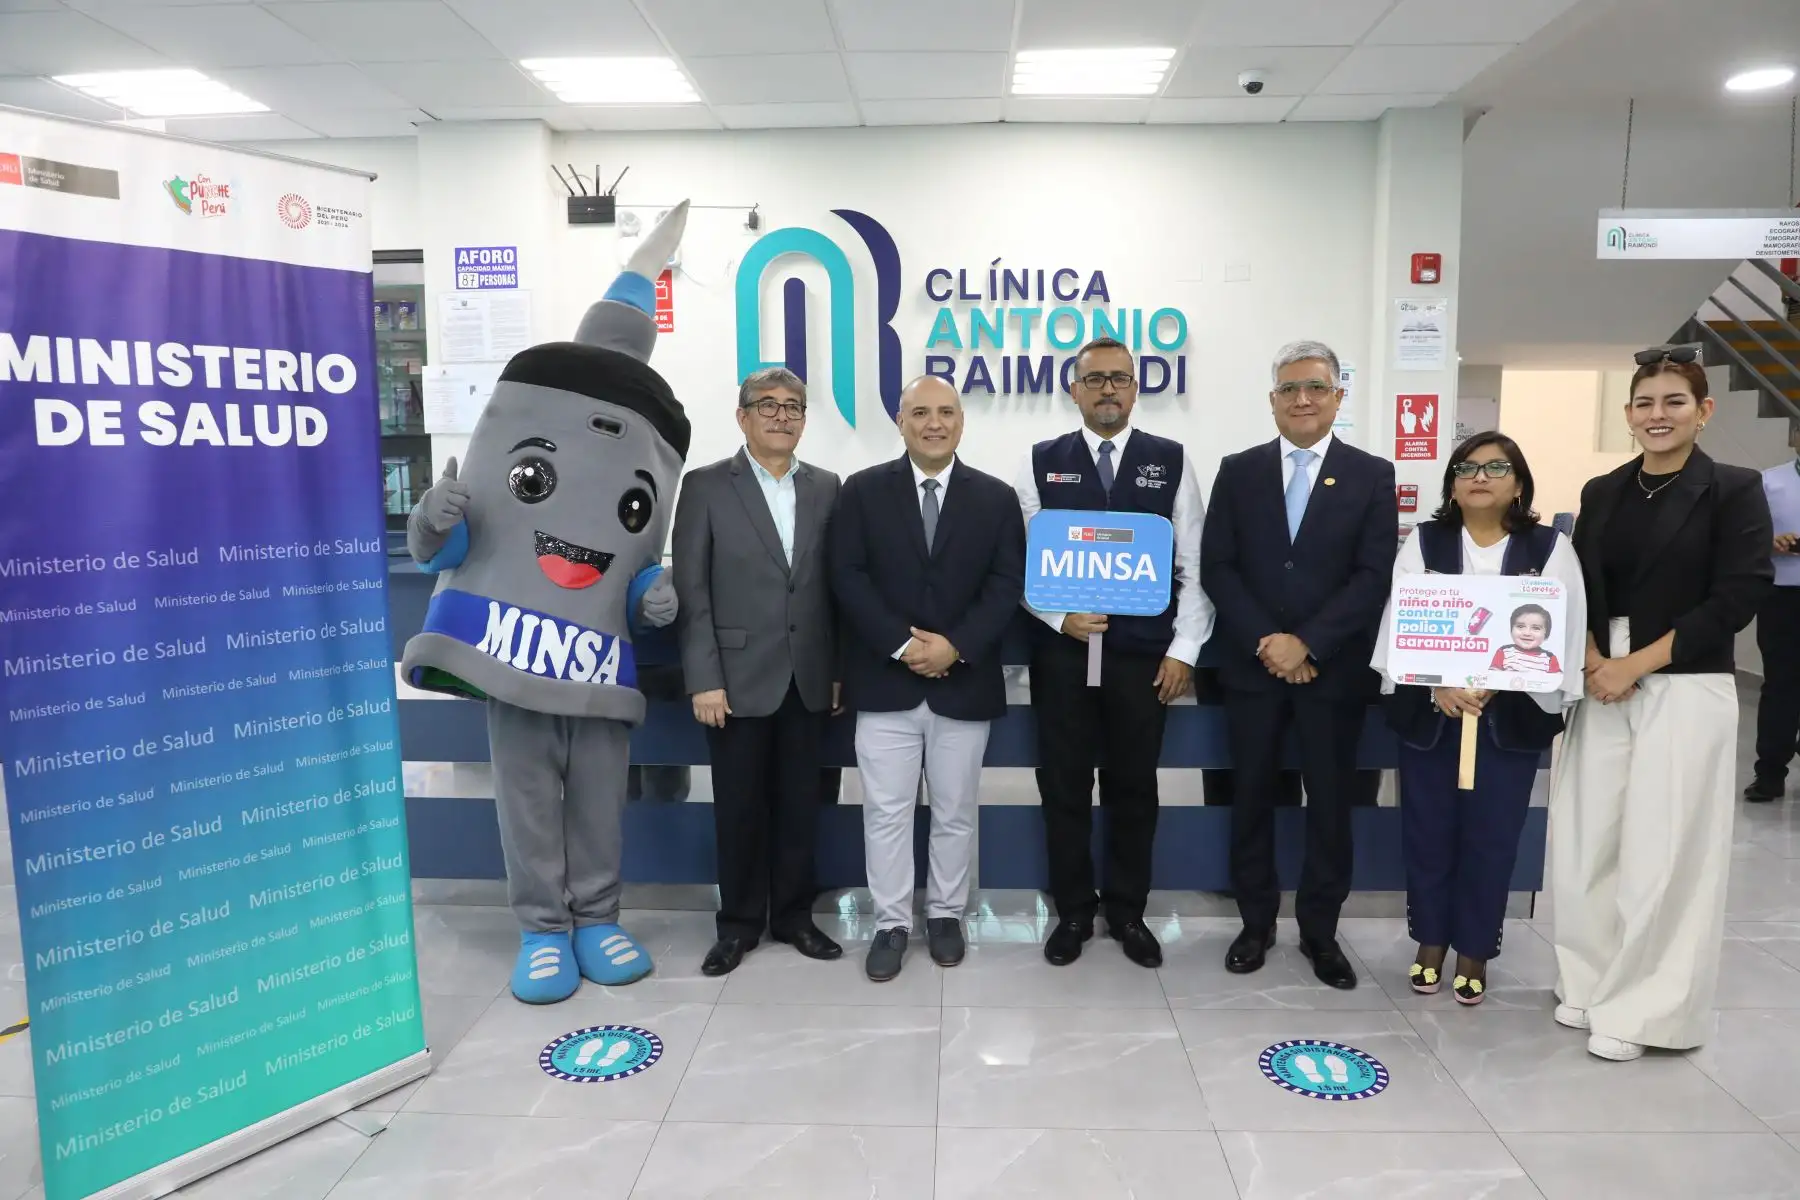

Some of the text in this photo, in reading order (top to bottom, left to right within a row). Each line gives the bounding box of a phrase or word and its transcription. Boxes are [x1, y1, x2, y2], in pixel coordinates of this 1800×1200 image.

[198, 174, 210, 183] Con
[202, 200, 226, 215] Perú
[316, 206, 362, 218] BICENTENARIO
[458, 249, 514, 264] AFORO
[462, 274, 516, 286] 87 PERSONAS
[926, 257, 1110, 302] CLÍNICA
[926, 306, 1188, 350] ANTONIO
[0, 333, 356, 394] MINISTERIO
[34, 398, 328, 446] DE SALUD
[0, 547, 198, 577] Ministerio de Salud
[220, 537, 380, 562] Ministerio de Salud
[1041, 549, 1157, 582] MINSA
[155, 588, 270, 608] Ministerio de Salud
[283, 578, 383, 596] Ministerio de Salud
[1399, 597, 1428, 607] niña
[1443, 598, 1473, 608] niño
[1400, 588, 1437, 597] Protege
[0, 599, 136, 622] Ministerio de Salud
[1398, 609, 1458, 618] contra la
[1400, 620, 1452, 634] polio y
[227, 616, 385, 649] Ministerio de Salud
[476, 601, 621, 686] MINSA
[1398, 636, 1486, 651] sarampión
[5, 636, 206, 677] Ministerio de Salud
[289, 658, 387, 680] Ministerio de Salud
[163, 672, 276, 699] Ministerio de Salud
[10, 692, 145, 722] Ministerio de Salud
[234, 698, 390, 738] Ministerio de Salud
[16, 727, 214, 777] Ministerio de Salud
[296, 740, 393, 767] Ministerio de Salud
[171, 761, 284, 793] Ministerio de Salud
[21, 788, 154, 824] Ministerio de Salud
[242, 777, 396, 825] Ministerio de Salud
[26, 815, 222, 875] Ministerio de Salud
[303, 816, 399, 848] Ministerio de Salud
[179, 843, 291, 880] Ministerio de Salud
[31, 876, 162, 918] Ministerio de Salud
[250, 852, 402, 909] Ministerio de Salud
[310, 891, 406, 928] Ministerio de Salud
[36, 900, 230, 971] Ministerio de Salud
[187, 924, 298, 968] Ministerio de Salud
[257, 929, 409, 993] Ministerio de Salud
[41, 963, 171, 1012] Ministerio de Salud
[47, 986, 238, 1065] Ministerio de Salud
[266, 1004, 414, 1076] Ministerio de Salud
[1304, 1047, 1354, 1062] DISTANCIA
[51, 1054, 180, 1110] Ministerio de Salud
[56, 1070, 246, 1160] Ministerio de Salud
